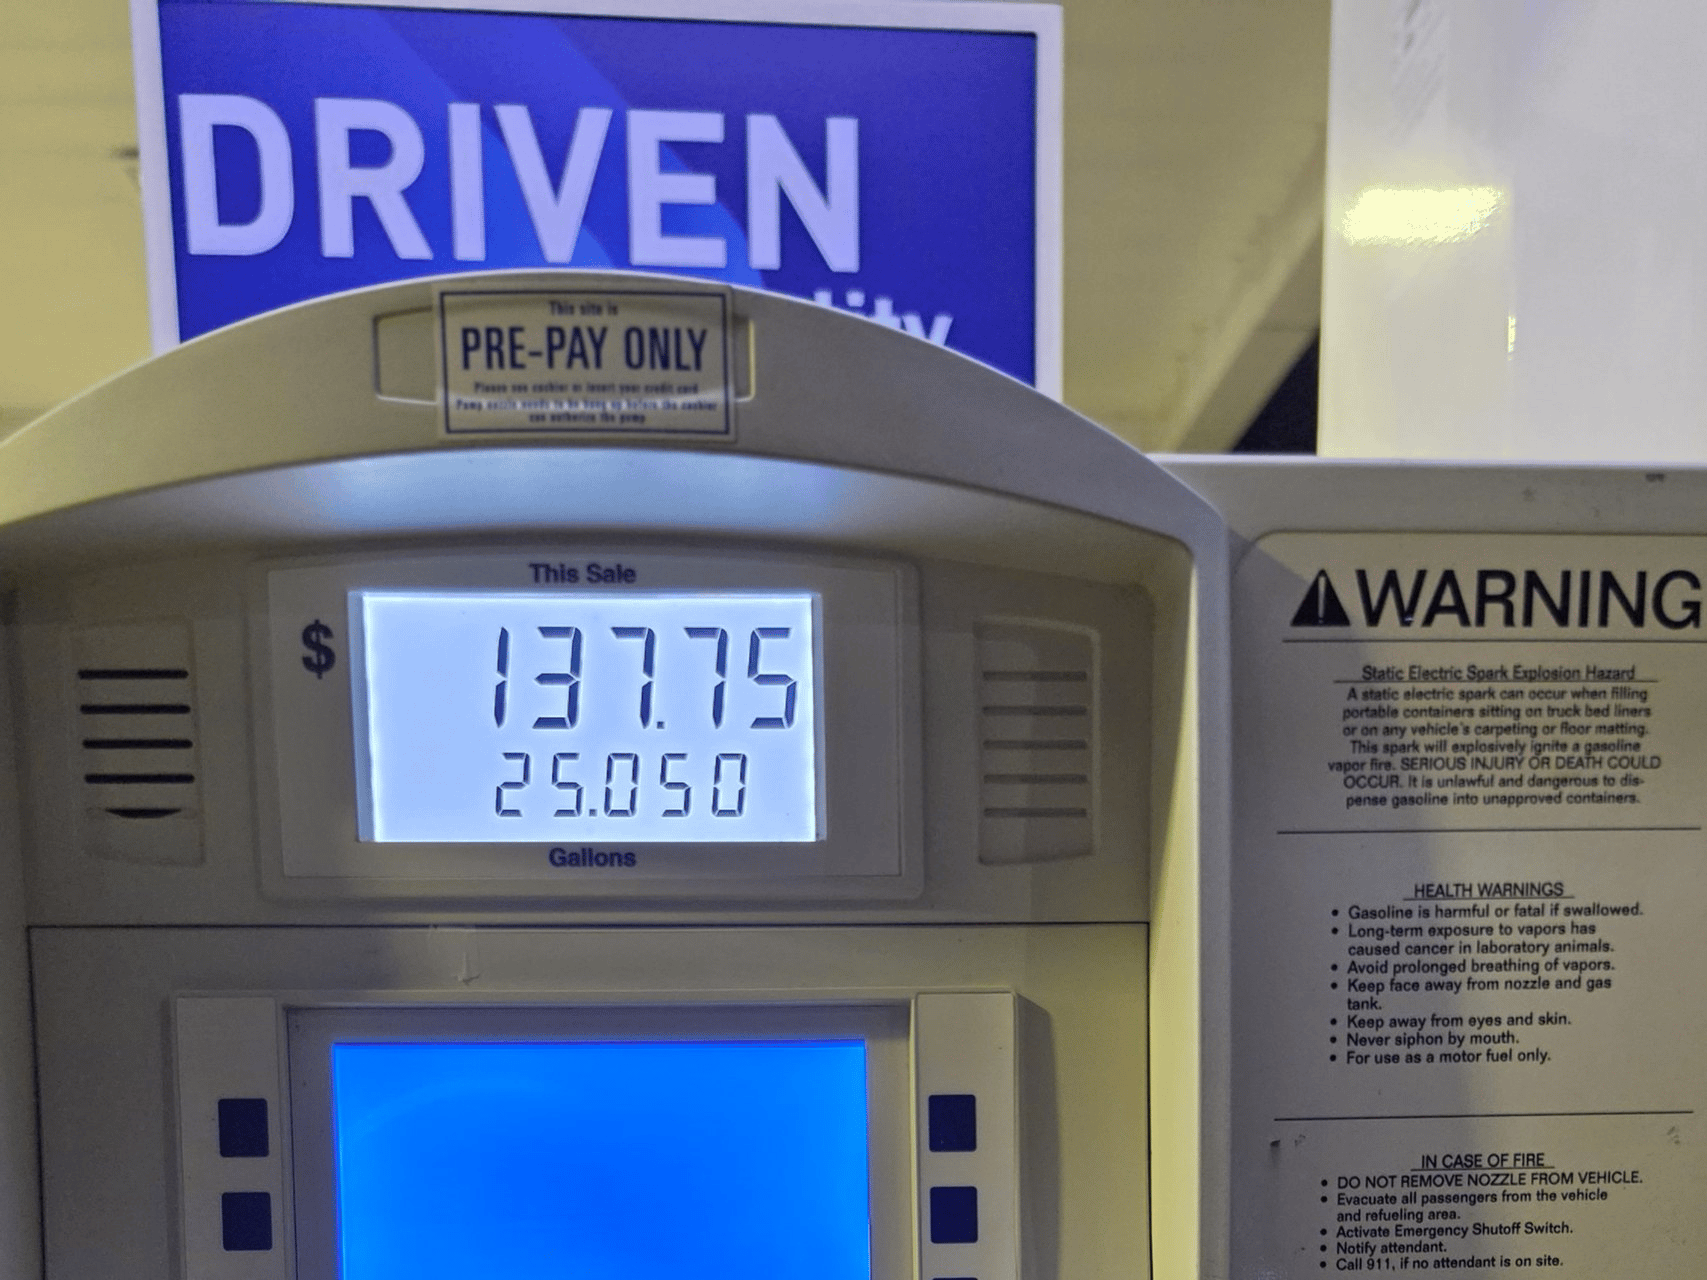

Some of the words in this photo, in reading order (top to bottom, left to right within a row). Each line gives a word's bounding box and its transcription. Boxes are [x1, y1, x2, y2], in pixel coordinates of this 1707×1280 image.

[178, 93, 860, 272] DRIVEN
[548, 298, 575, 314] This
[579, 300, 603, 315] site
[606, 299, 618, 315] is
[461, 326, 608, 370] PRE-PAY
[623, 326, 707, 370] ONLY
[529, 564, 580, 584] This
[586, 564, 637, 584] Sale
[1355, 568, 1702, 630] WARNING
[301, 619, 335, 679] $
[493, 626, 798, 729] 137.75
[1362, 664, 1403, 682] Static
[1408, 664, 1461, 682] Electric
[1467, 664, 1507, 682] Spark
[1513, 664, 1580, 682] Explosion
[1586, 665, 1634, 682] Hazard
[1347, 687, 1358, 700] A
[1361, 687, 1399, 700] static
[1403, 687, 1454, 700] electric
[1458, 687, 1495, 702] spark
[1499, 690, 1524, 699] can
[1528, 690, 1567, 699] occur
[1570, 686, 1607, 699] when
[1611, 686, 1648, 702] filling
[1327, 761, 1366, 774] vapor
[1369, 758, 1399, 771] fire.
[1400, 756, 1466, 770] SERIOUS
[1470, 756, 1524, 769] INJURY
[1528, 755, 1550, 769] OR
[1555, 754, 1603, 769] DEATH
[1607, 755, 1662, 769] COULD
[495, 751, 747, 817] 25.050
[548, 847, 637, 868] Gallons
[1414, 883, 1472, 900] HEALTH
[1477, 882, 1563, 899] WARNINGS
[1348, 904, 1413, 919] Gasoline
[1418, 908, 1430, 918] is
[1434, 904, 1490, 917] harmful
[1494, 908, 1510, 917] or
[1514, 903, 1545, 916] fatal
[1550, 903, 1560, 915] if
[1563, 902, 1643, 916] swallowed.
[1347, 1014, 1384, 1031] Keep
[1388, 1017, 1426, 1031] away
[1430, 1013, 1463, 1026] from
[1468, 1016, 1502, 1029] eyes
[1506, 1012, 1533, 1025] and
[1538, 1011, 1570, 1025] skin.
[1346, 1032, 1391, 1046] Never
[1394, 1031, 1443, 1048] siphon
[1447, 1031, 1465, 1048] by
[1469, 1030, 1519, 1044] mouth.
[1422, 1154, 1437, 1170] IN
[1442, 1154, 1482, 1170] CASE
[1487, 1153, 1508, 1169] OF
[1513, 1152, 1544, 1169] FIRE
[1337, 1176, 1360, 1188] DO
[1365, 1175, 1397, 1188] NOT
[1401, 1174, 1463, 1187] REMOVE
[1467, 1173, 1526, 1186] NOZZLE
[1531, 1172, 1573, 1185] FROM
[1578, 1170, 1642, 1184] VEHICLE.
[1335, 1225, 1390, 1237] Activate
[1394, 1223, 1468, 1239] Emergency
[1472, 1222, 1521, 1235] Shutoff
[1524, 1221, 1573, 1234] Switch.
[1335, 1257, 1362, 1270] Call
[1366, 1258, 1395, 1270] 911,
[1400, 1256, 1409, 1268] if
[1412, 1260, 1429, 1268] no
[1432, 1255, 1496, 1268] attendant
[1499, 1255, 1511, 1266] is
[1514, 1258, 1532, 1266] on
[1535, 1254, 1563, 1266] site.
